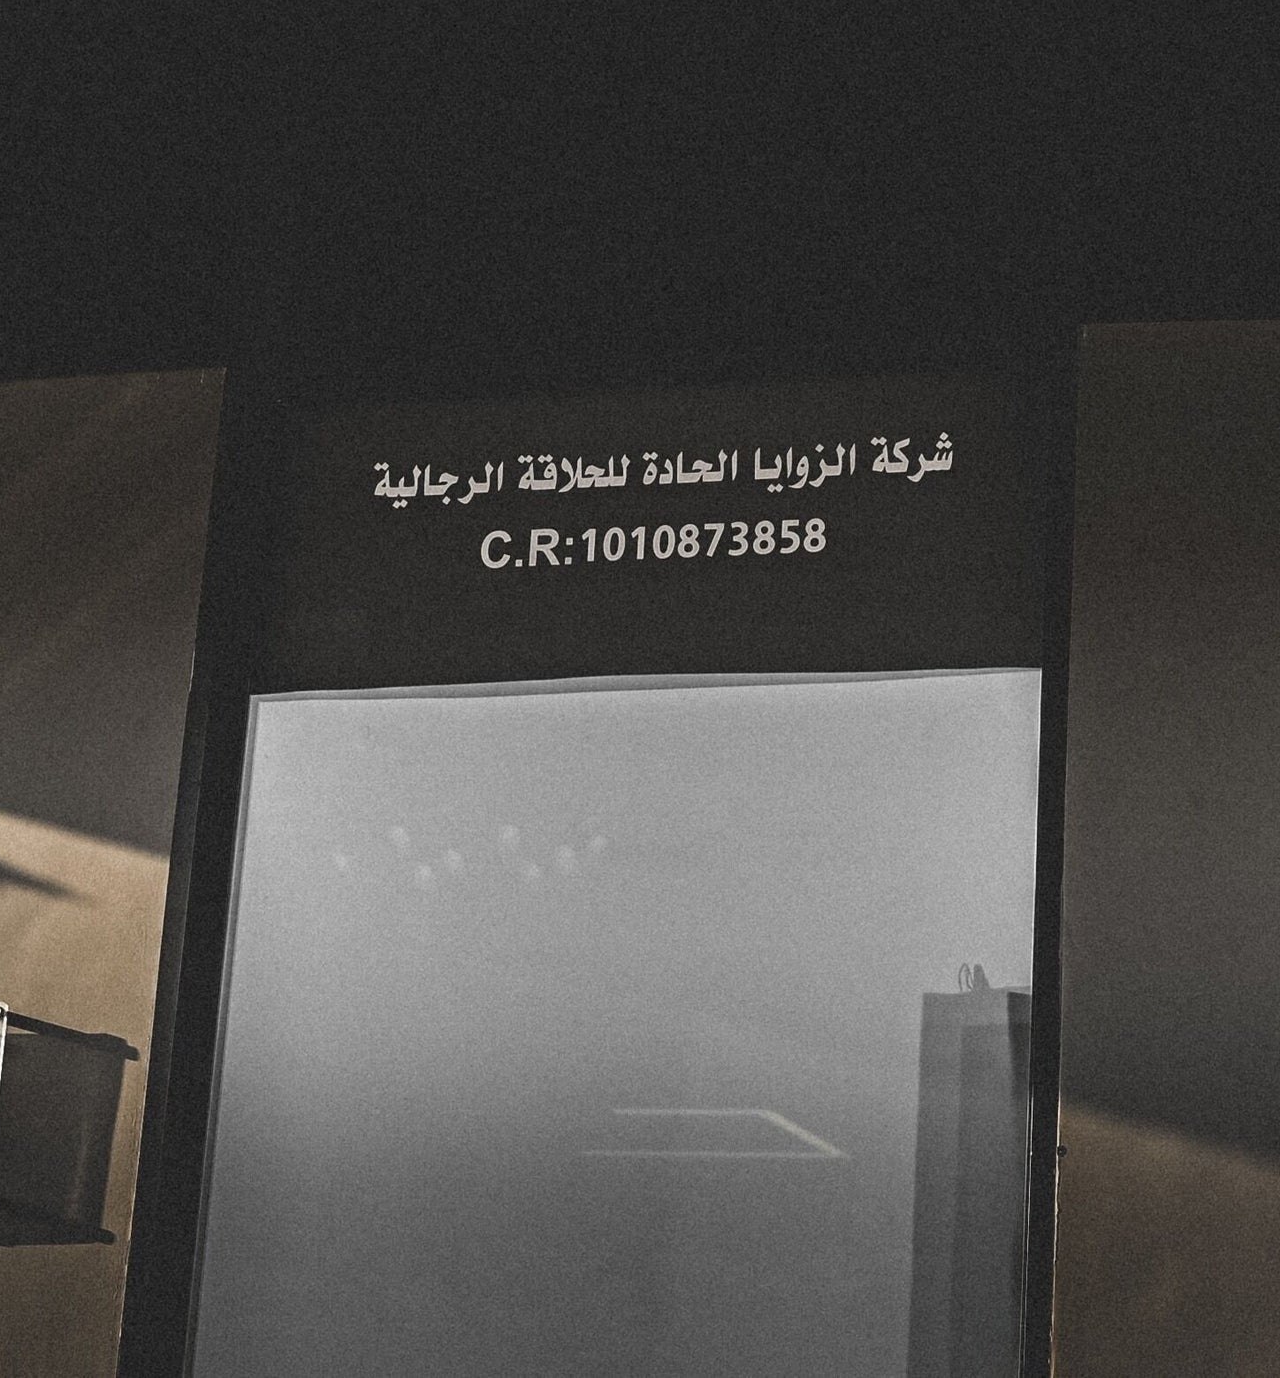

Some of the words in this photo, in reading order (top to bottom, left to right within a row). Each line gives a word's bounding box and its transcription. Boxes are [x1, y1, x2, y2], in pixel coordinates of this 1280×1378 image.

[517, 454, 631, 493] للحلاقة
[642, 449, 738, 486] الحادة
[754, 443, 856, 493] الزوايا
[870, 431, 954, 483] شركة
[373, 461, 504, 509] الرجالية
[480, 517, 827, 569] C.R:1010873858
